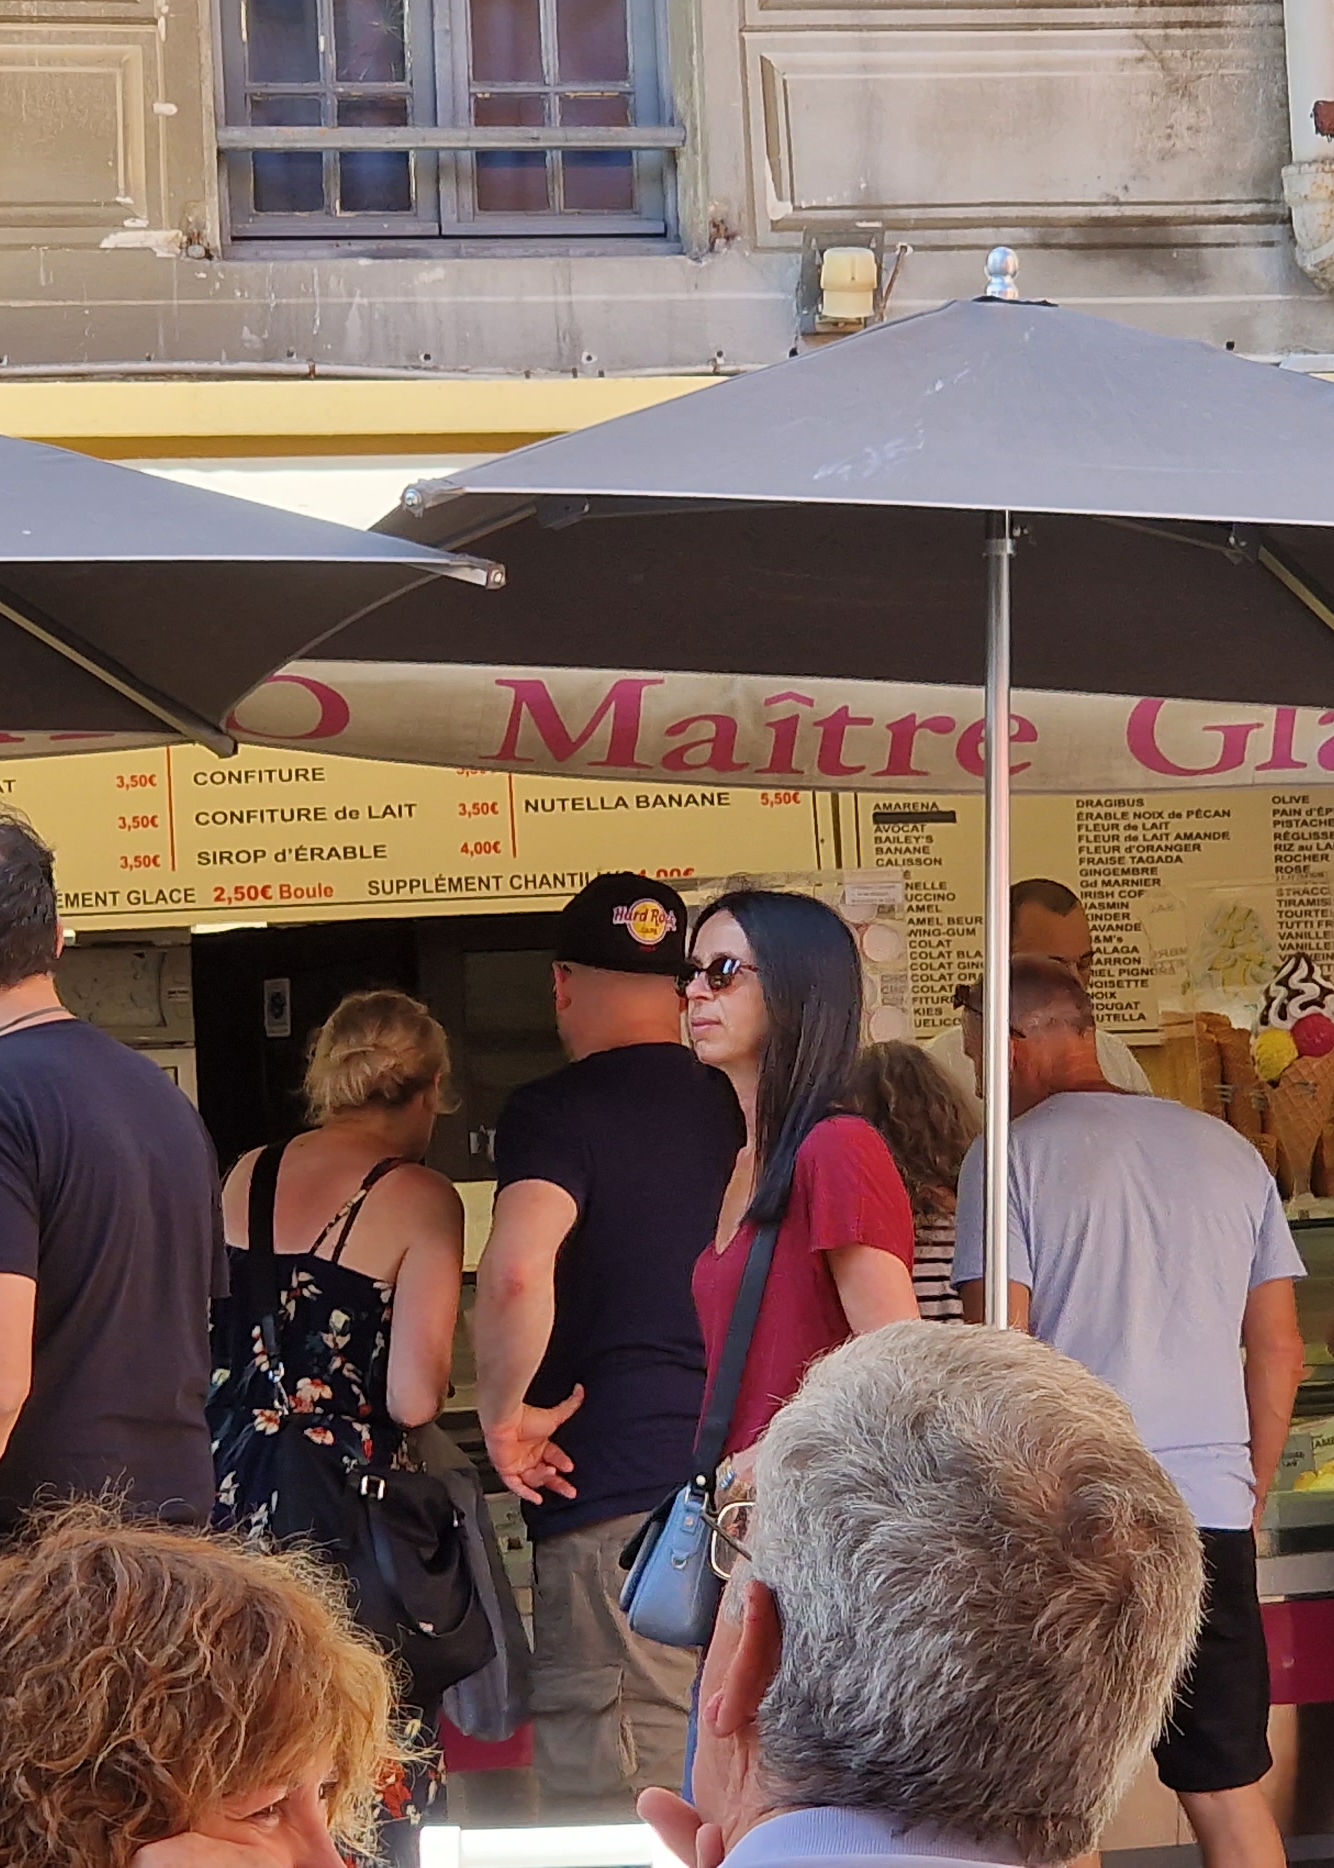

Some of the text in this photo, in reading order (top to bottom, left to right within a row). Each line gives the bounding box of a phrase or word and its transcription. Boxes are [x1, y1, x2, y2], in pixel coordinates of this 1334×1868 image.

[479, 678, 1039, 777] Maître
[193, 767, 326, 786] CONFITURE
[116, 774, 158, 791] 3,50€
[525, 792, 802, 813] NUTELLA BANANE 5,50€
[1076, 798, 1145, 808] DRAGIBUS
[1271, 795, 1311, 805] OLIVE
[873, 802, 940, 811] AMARENA
[195, 802, 500, 826] CONFITURE de LAIT 3,50€
[1077, 807, 1232, 821] ÉRABLE NOIX de PÉCAN
[1272, 807, 1303, 818] PAIN
[118, 815, 159, 831] 3,50€
[1077, 821, 1171, 833] FLEUR de LAIT
[874, 824, 927, 833] AVOCAT
[874, 835, 934, 845] BAILEY'S
[1078, 831, 1231, 844] FLEUR de LAIT AMANDE
[875, 846, 931, 855] BANANE
[1078, 845, 1121, 855] FLEUR
[1274, 843, 1295, 852] RIZ
[1297, 844, 1313, 852] au
[197, 841, 502, 866] SIROP d'ÉRABLE 4,00€
[120, 854, 161, 871] 3,50€
[876, 857, 942, 867] CALISSON
[1079, 855, 1184, 866] FRAISE TAGADA
[1274, 854, 1331, 864] ROCHER
[1079, 866, 1159, 877] GINGEMBRE
[1275, 865, 1311, 875] ROSE
[127, 886, 196, 905] GLACE
[213, 884, 273, 905] 2,50€
[279, 883, 334, 900] Boule
[367, 873, 504, 896] SUPPLÉMENT
[509, 870, 607, 891] CHANTIL
[905, 881, 948, 891] NELLE
[1080, 878, 1162, 889] Gd MARNIER
[905, 892, 956, 902] UCCINO
[1080, 890, 1146, 900] IRISH COF
[907, 916, 983, 926] AMEL BEUR
[1277, 920, 1314, 930] TUTTI
[908, 927, 977, 937] WING-GUM
[1090, 923, 1142, 932] AVANDE
[1091, 934, 1124, 944] &M's
[1278, 931, 1333, 941] VANILLE
[909, 939, 953, 949] COLAT
[1278, 941, 1332, 951] VANILLE
[910, 950, 983, 960] COLAT BLA
[1094, 945, 1140, 955] ALAGA
[910, 962, 954, 971] COLAT
[1091, 957, 1142, 966] ARRON
[1092, 1001, 1141, 1011] OUGAT
[913, 1007, 943, 1016] KIES
[1095, 1012, 1147, 1023] UTELLA
